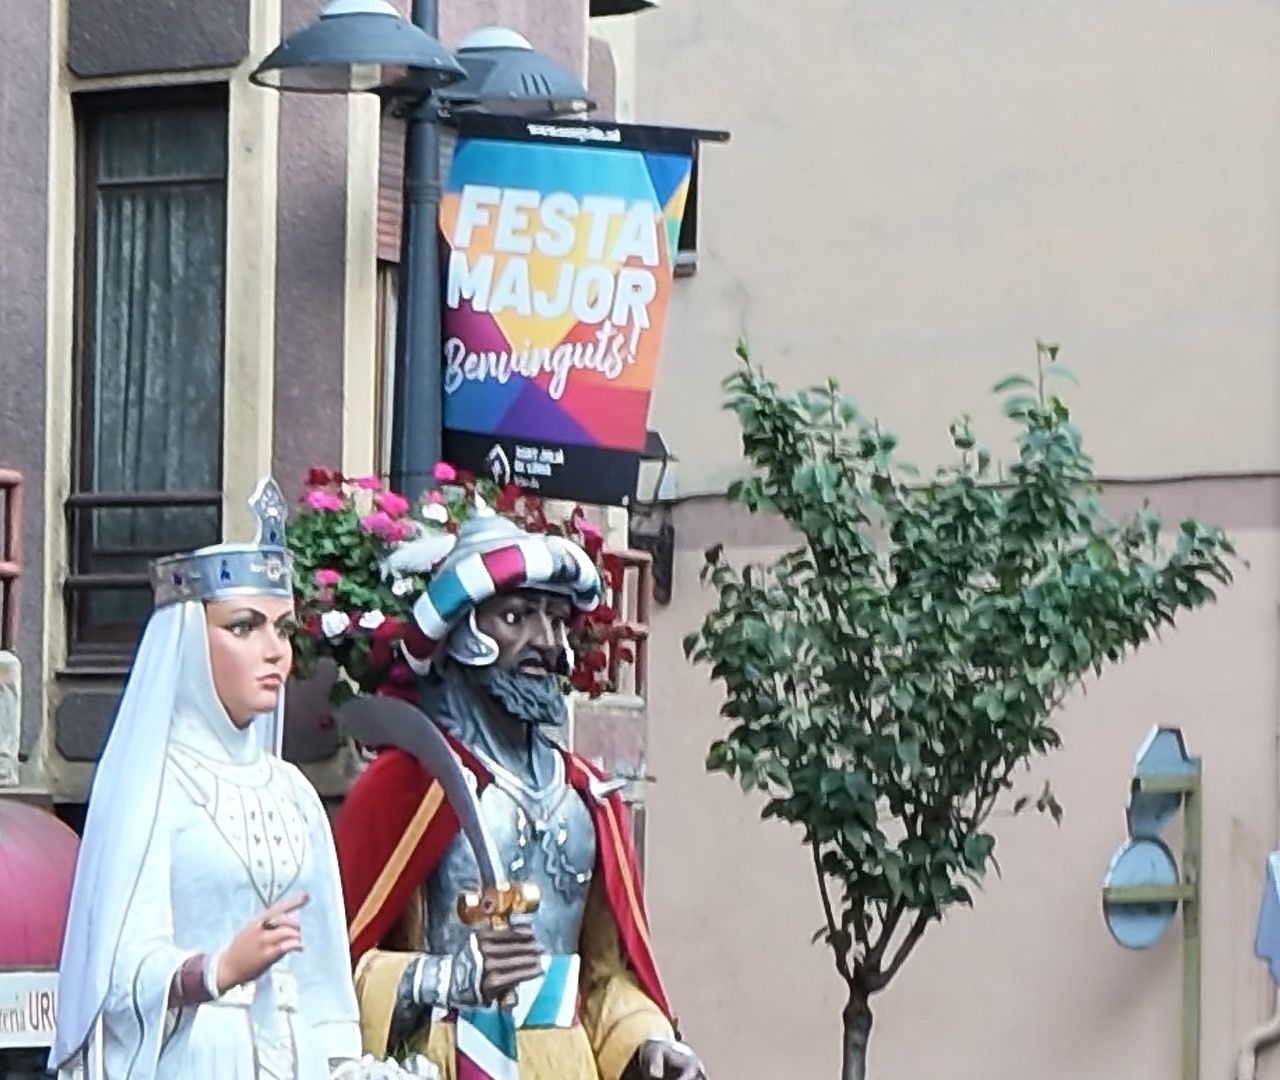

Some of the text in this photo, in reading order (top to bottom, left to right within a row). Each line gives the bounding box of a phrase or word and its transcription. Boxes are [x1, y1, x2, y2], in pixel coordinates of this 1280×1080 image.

[454, 184, 659, 266] FESTA
[447, 250, 657, 328] MAJOR
[444, 319, 639, 400] Benvinguts!
